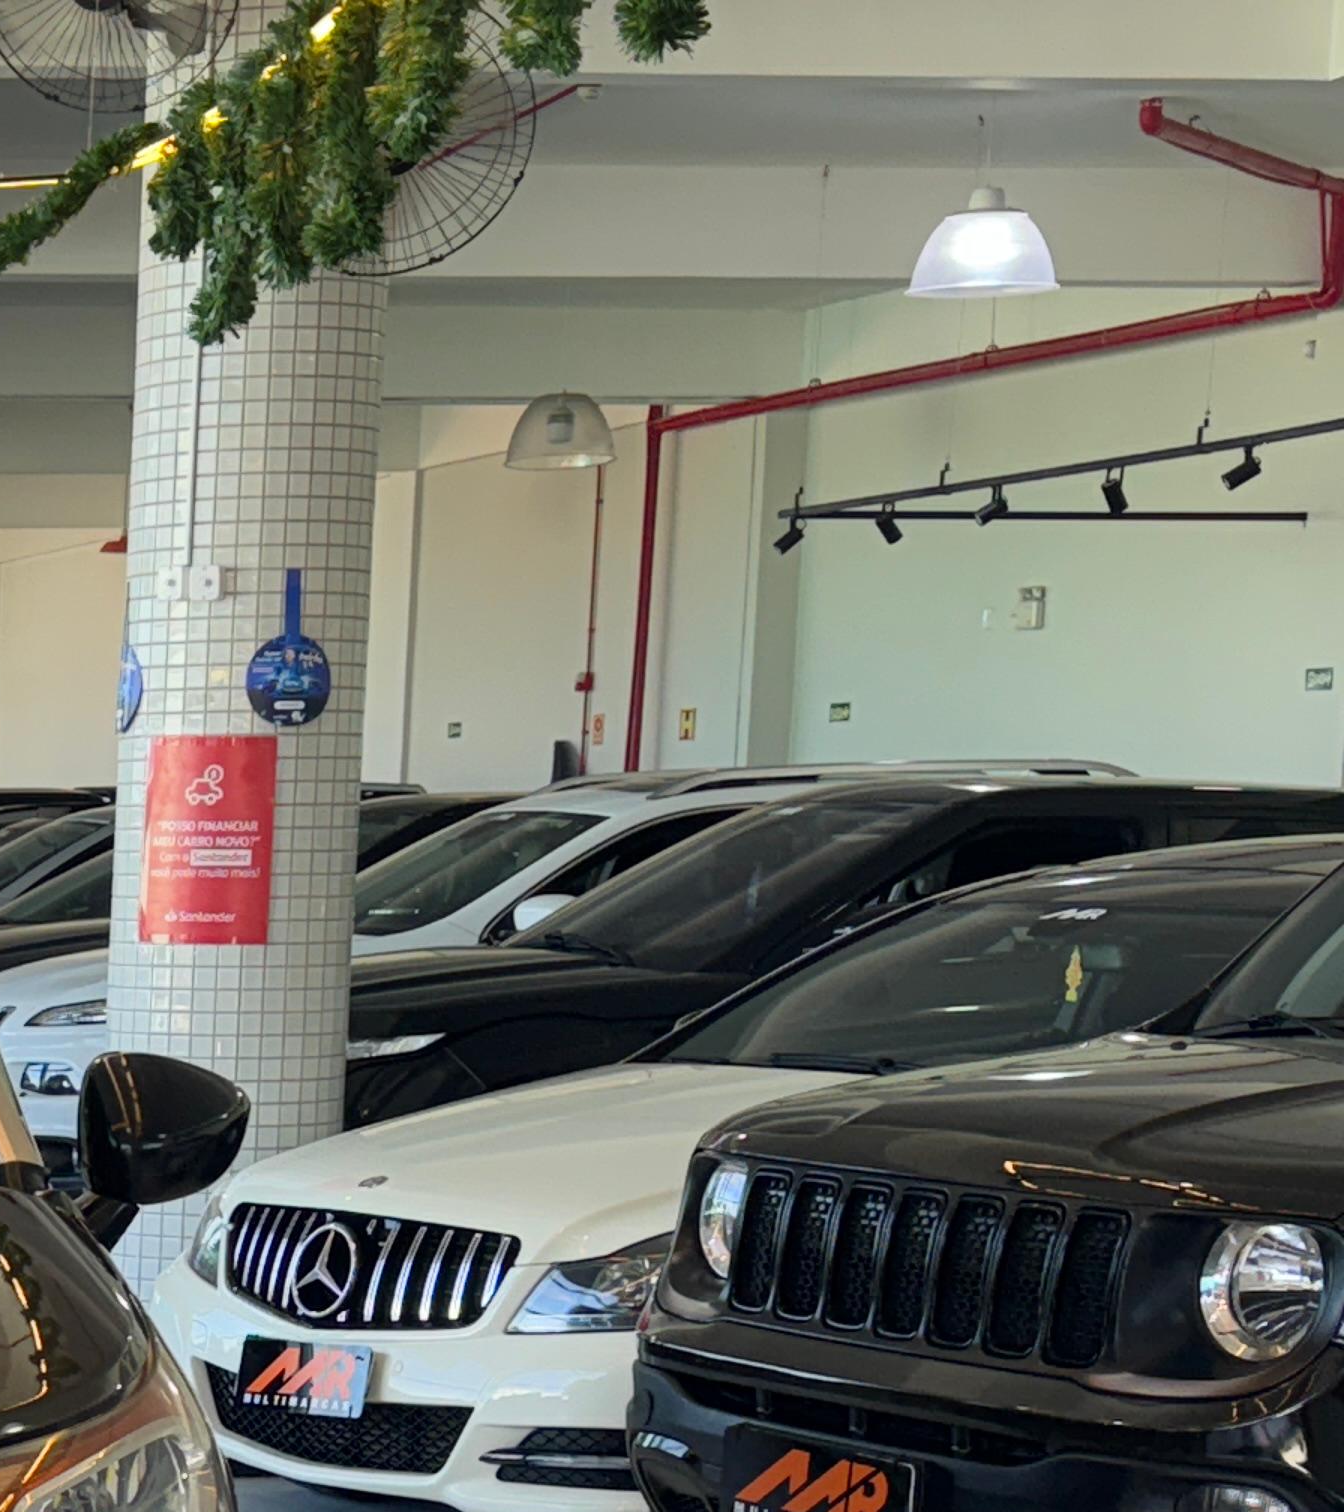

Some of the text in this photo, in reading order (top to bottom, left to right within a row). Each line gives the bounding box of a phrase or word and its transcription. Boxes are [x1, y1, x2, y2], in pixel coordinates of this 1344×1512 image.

[198, 820, 259, 832] FINANCIAR
[152, 835, 175, 847] MEU
[177, 835, 213, 847] CARRO
[193, 852, 249, 862] Santander
[179, 911, 236, 922] Santander
[242, 1393, 352, 1412] MULTIMARCAS
